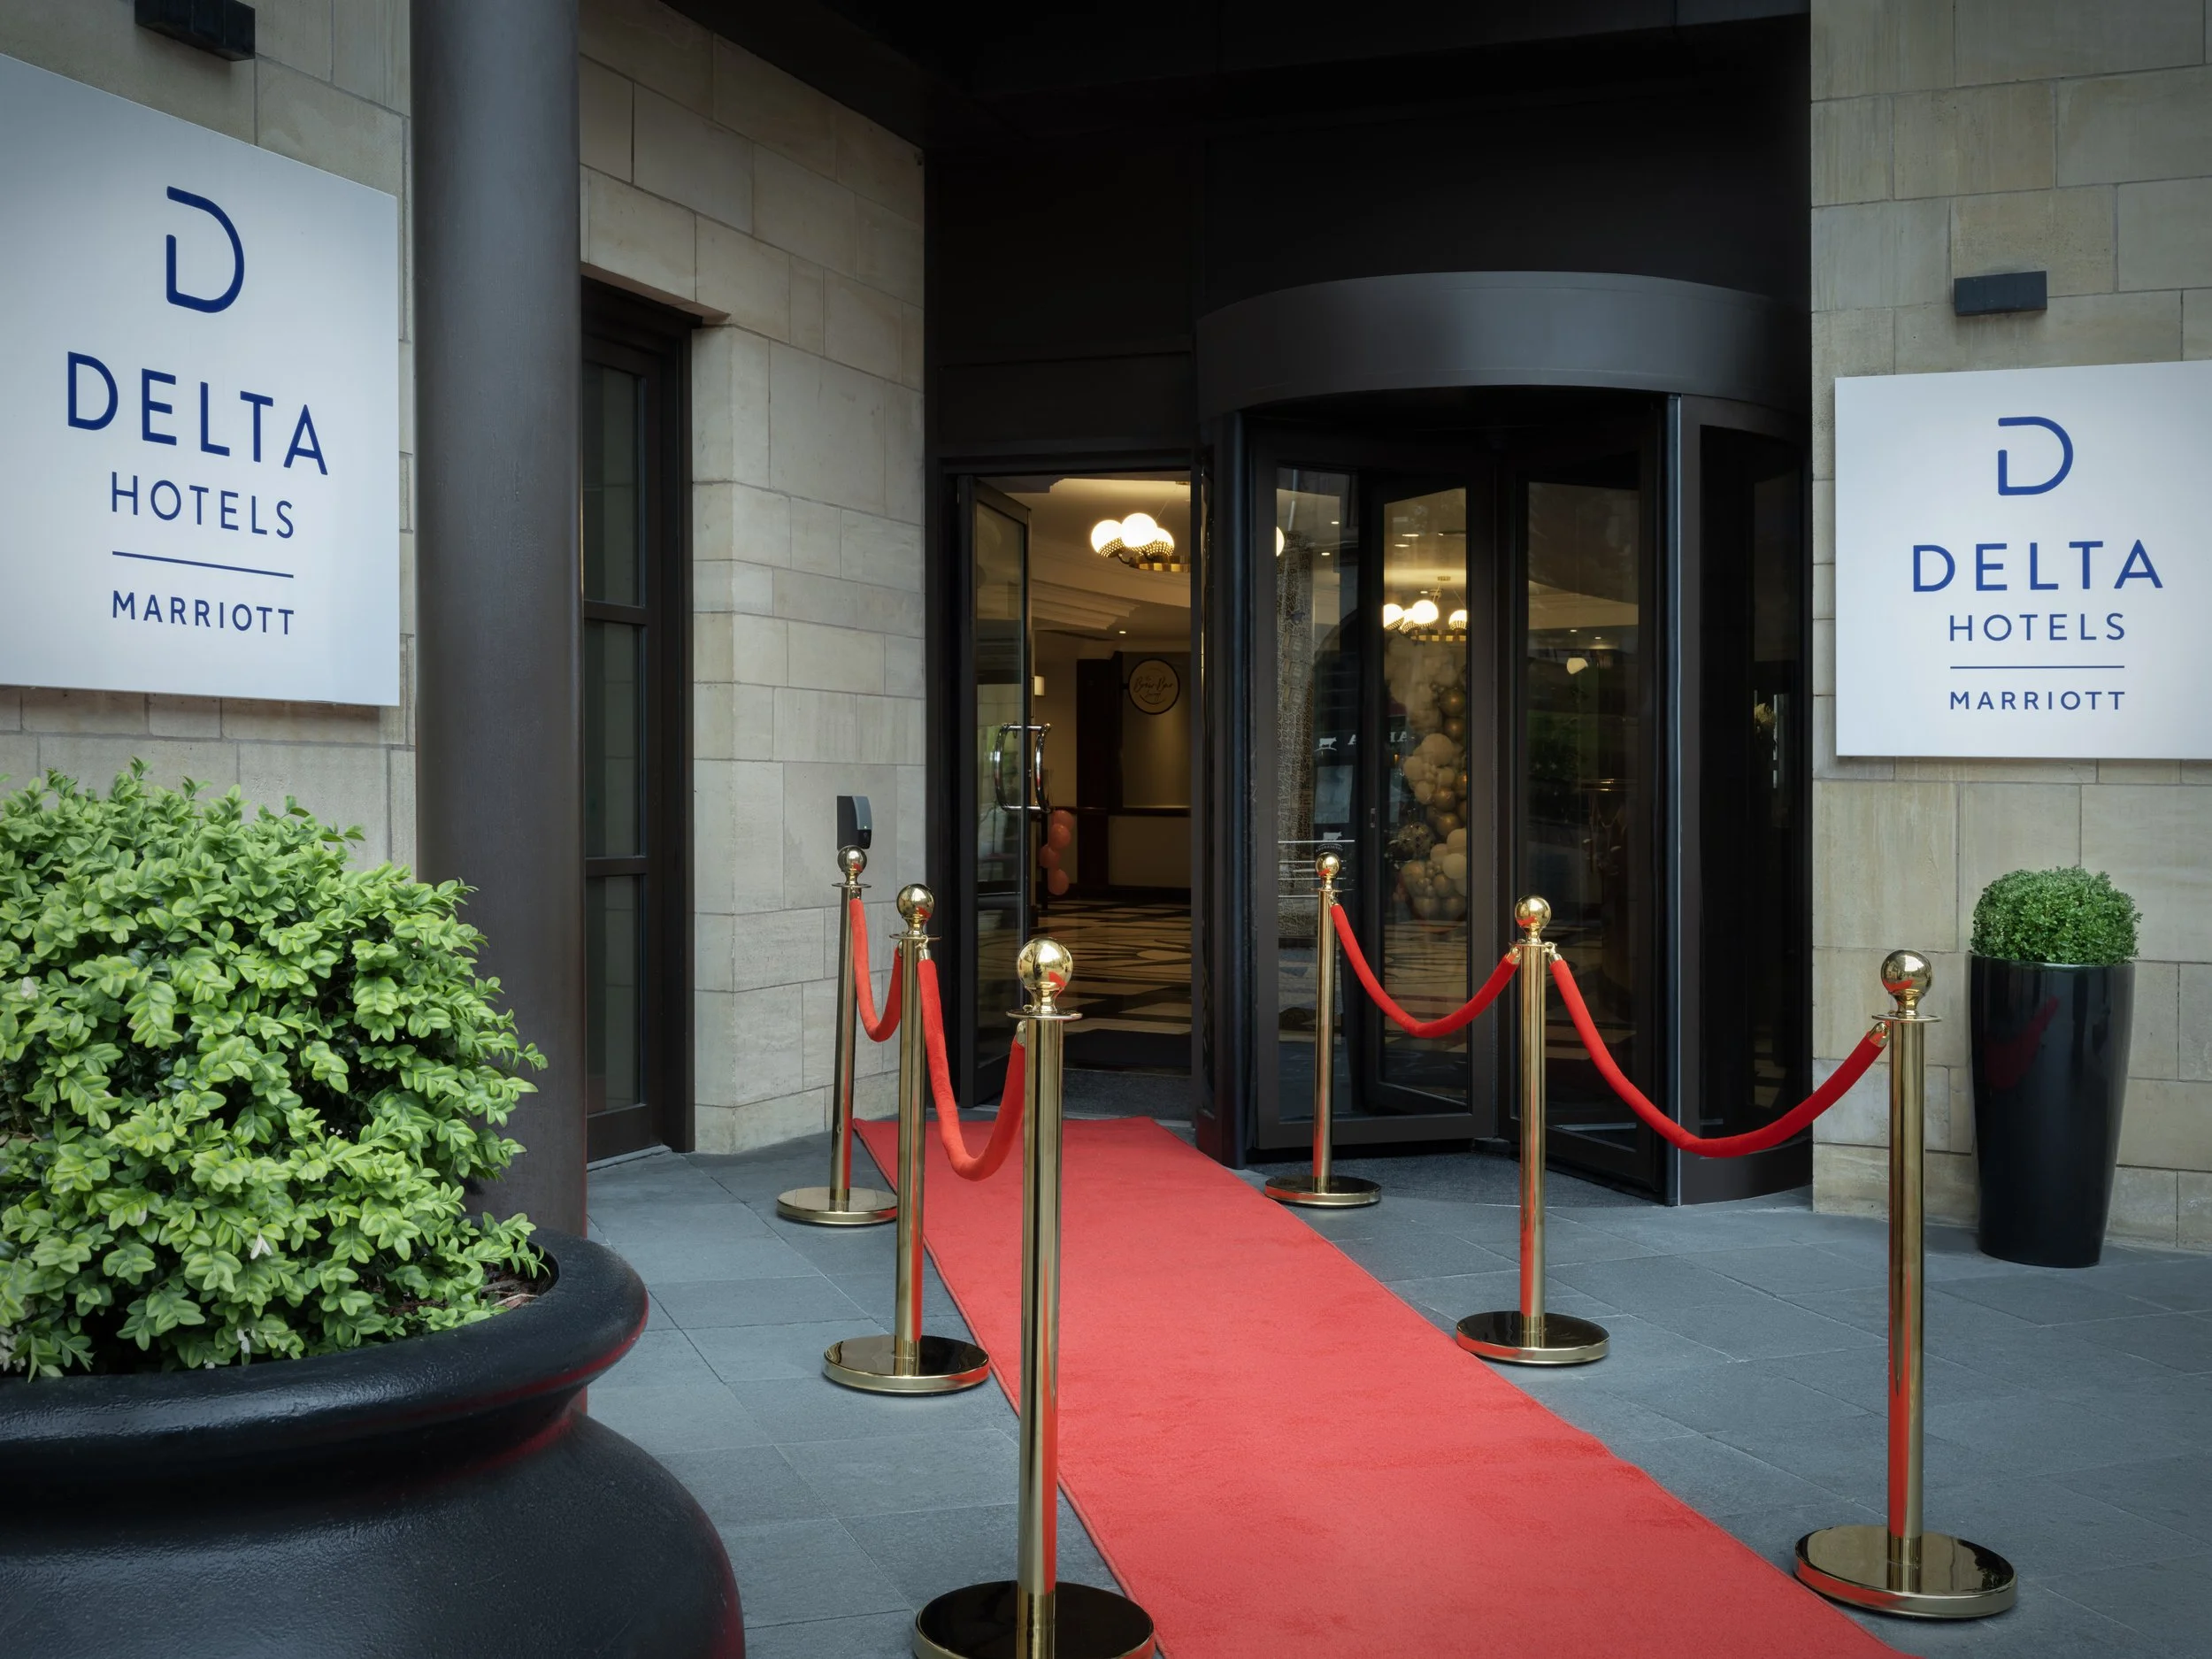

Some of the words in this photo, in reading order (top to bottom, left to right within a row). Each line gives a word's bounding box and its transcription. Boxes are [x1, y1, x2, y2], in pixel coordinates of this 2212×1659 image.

[67, 351, 328, 476] DELTA
[111, 471, 295, 539] HOTELS
[1913, 539, 2163, 592] DELTA
[112, 590, 295, 635] MARRIOTT
[1949, 612, 2125, 641] HOTELS
[1949, 690, 2125, 710] MARRIOTT
